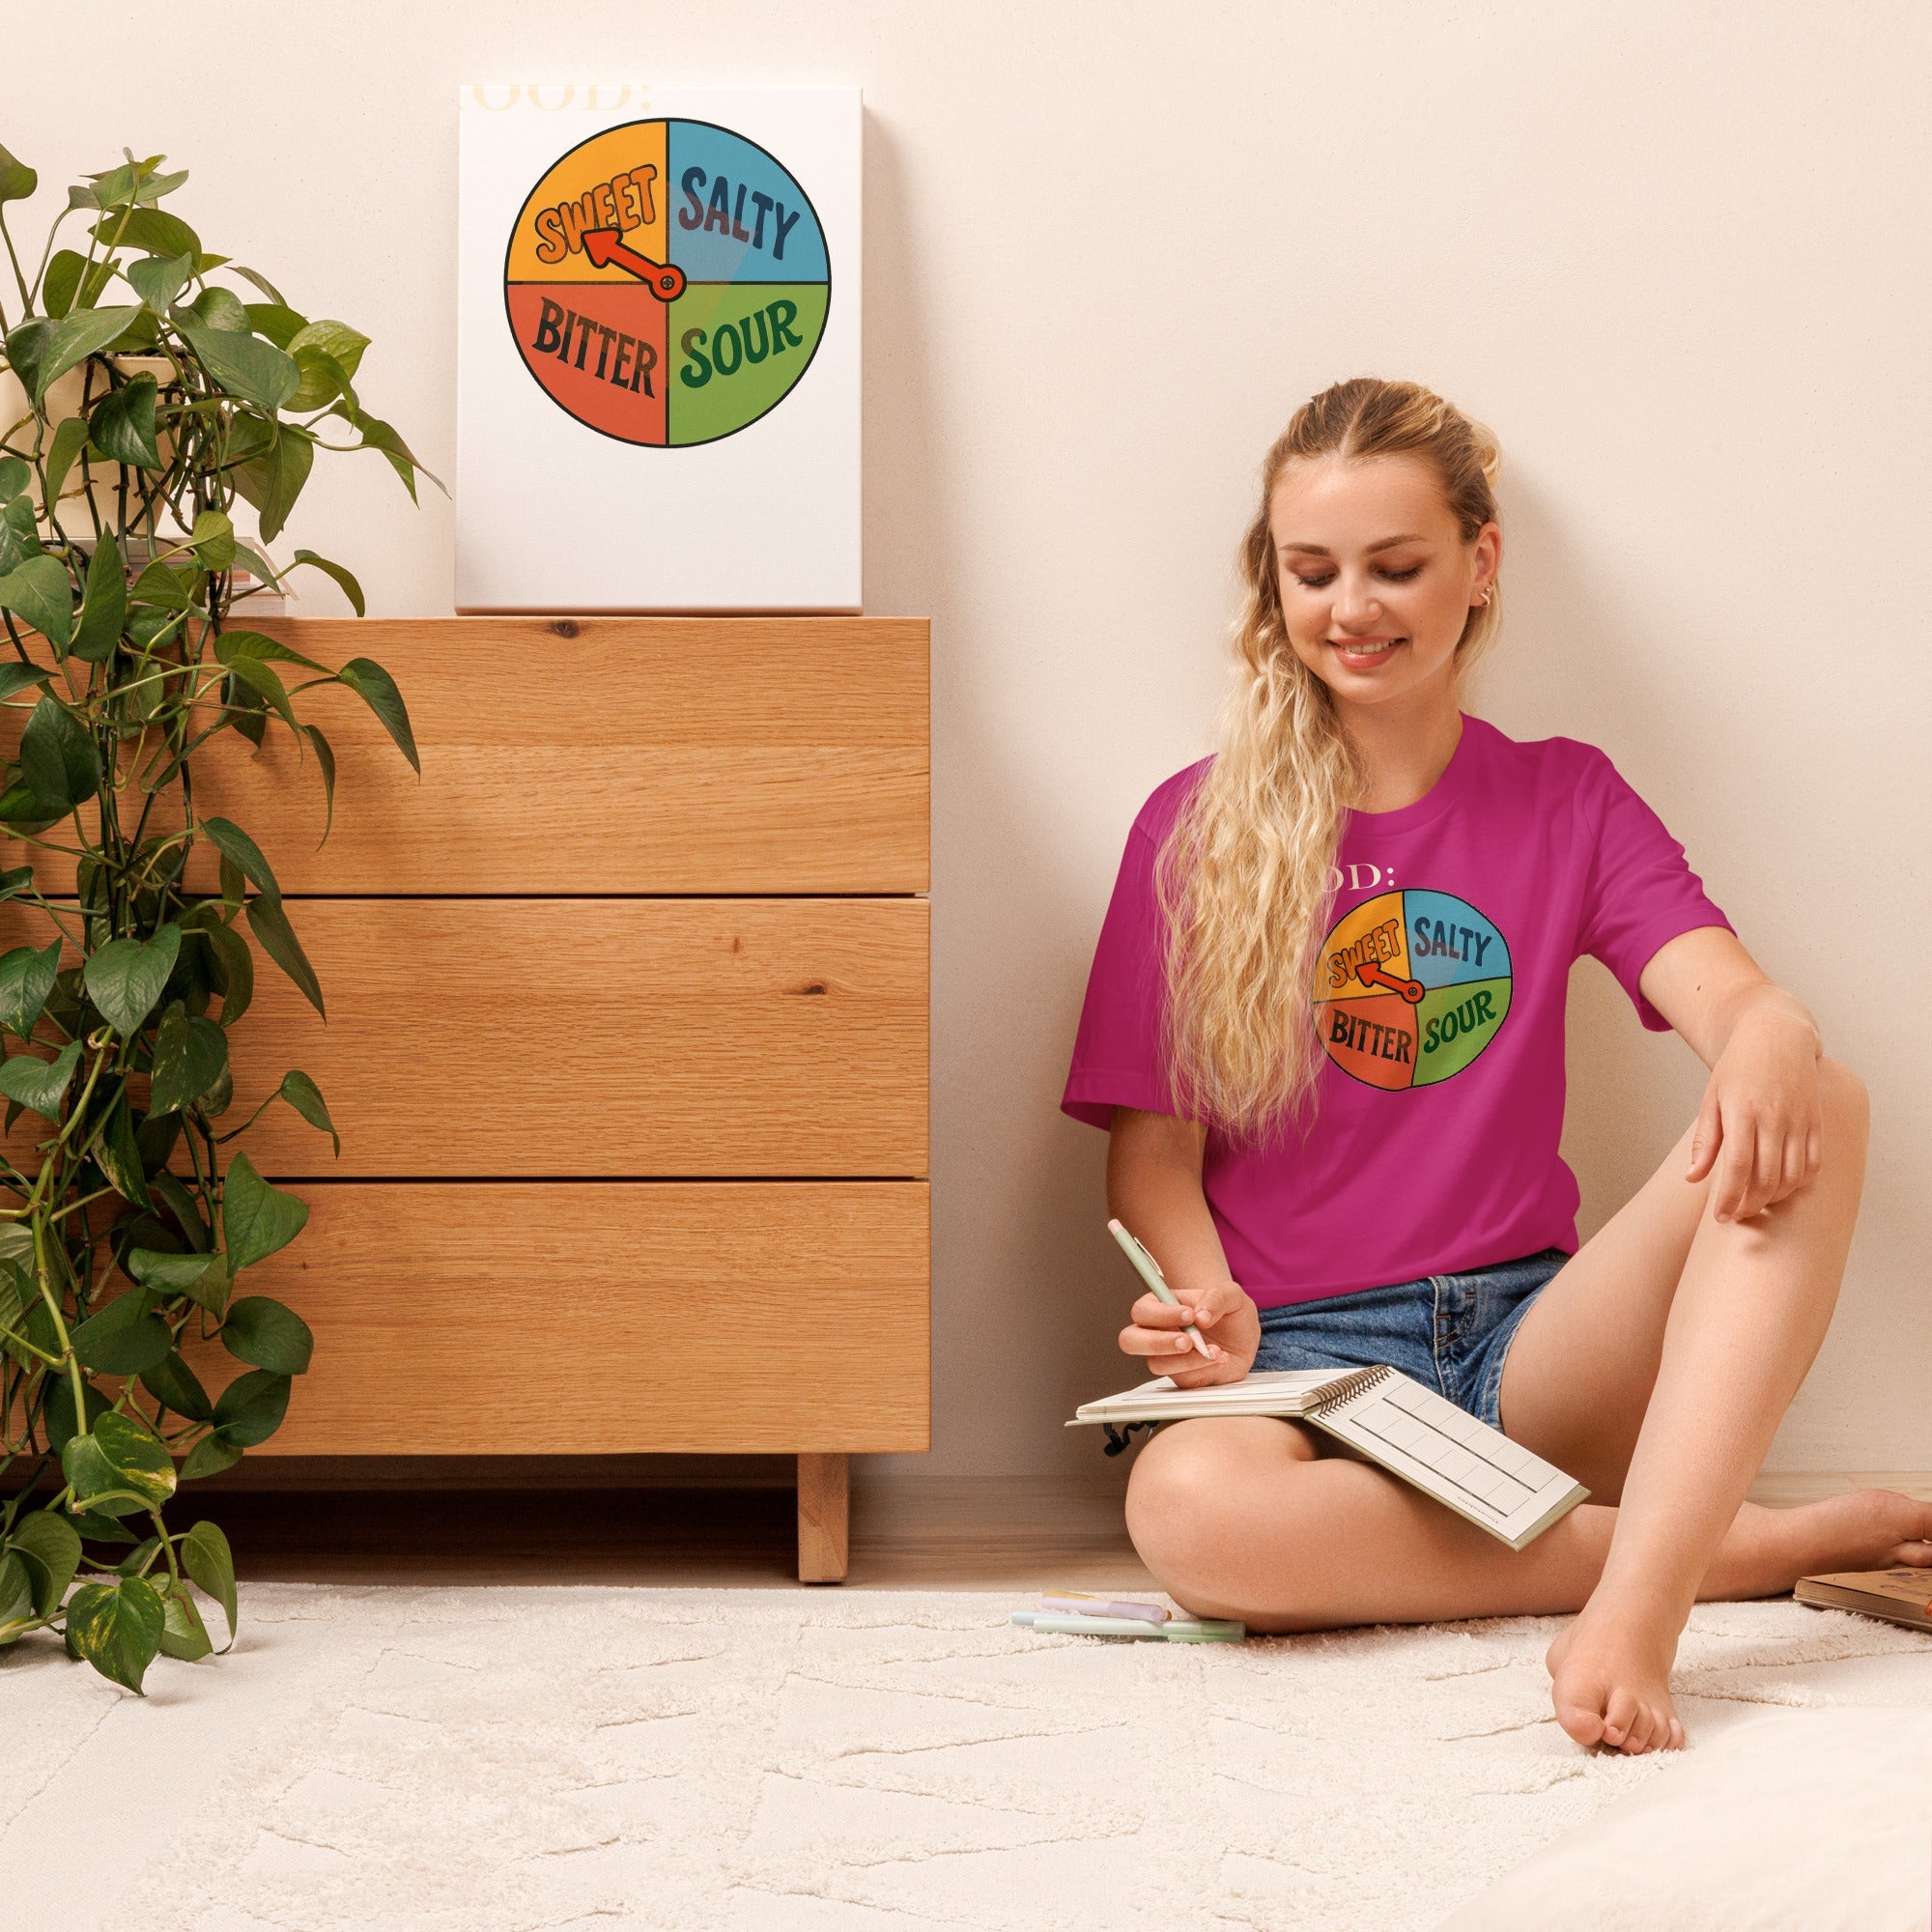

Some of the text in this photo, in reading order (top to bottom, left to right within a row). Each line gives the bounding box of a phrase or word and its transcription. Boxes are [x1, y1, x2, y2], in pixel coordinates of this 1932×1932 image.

[460, 85, 651, 111] OOD:
[534, 163, 658, 265] SWEET
[678, 166, 801, 261] SALTY
[531, 296, 658, 399] BITTER
[680, 299, 804, 388] SOUR
[1327, 919, 1400, 988] SWEET
[1414, 917, 1492, 967] SALTY
[1329, 1009, 1412, 1065] BITTER
[1424, 989, 1497, 1054] SOUR
